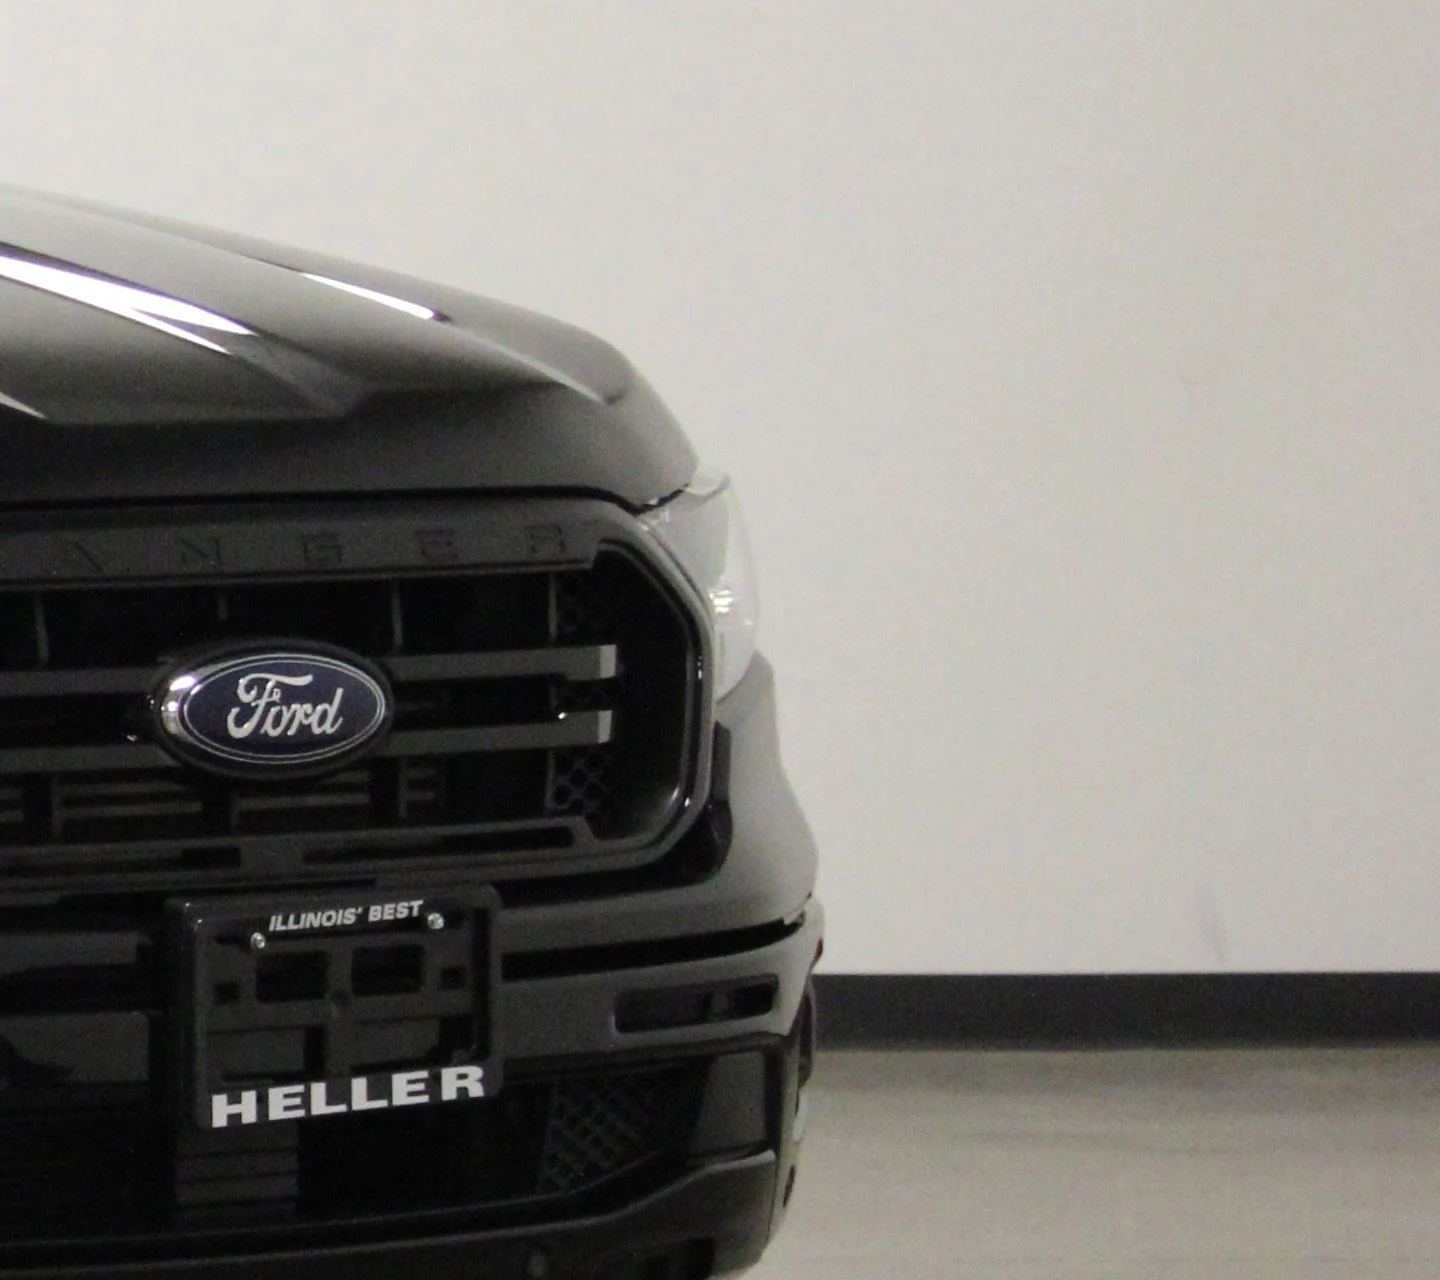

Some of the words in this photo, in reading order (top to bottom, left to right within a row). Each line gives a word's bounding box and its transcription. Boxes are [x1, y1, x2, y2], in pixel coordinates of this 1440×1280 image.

[226, 672, 344, 740] Ford
[268, 906, 362, 932] ILLINOIS'
[367, 899, 424, 923] BEST
[211, 1065, 485, 1129] HELLER
